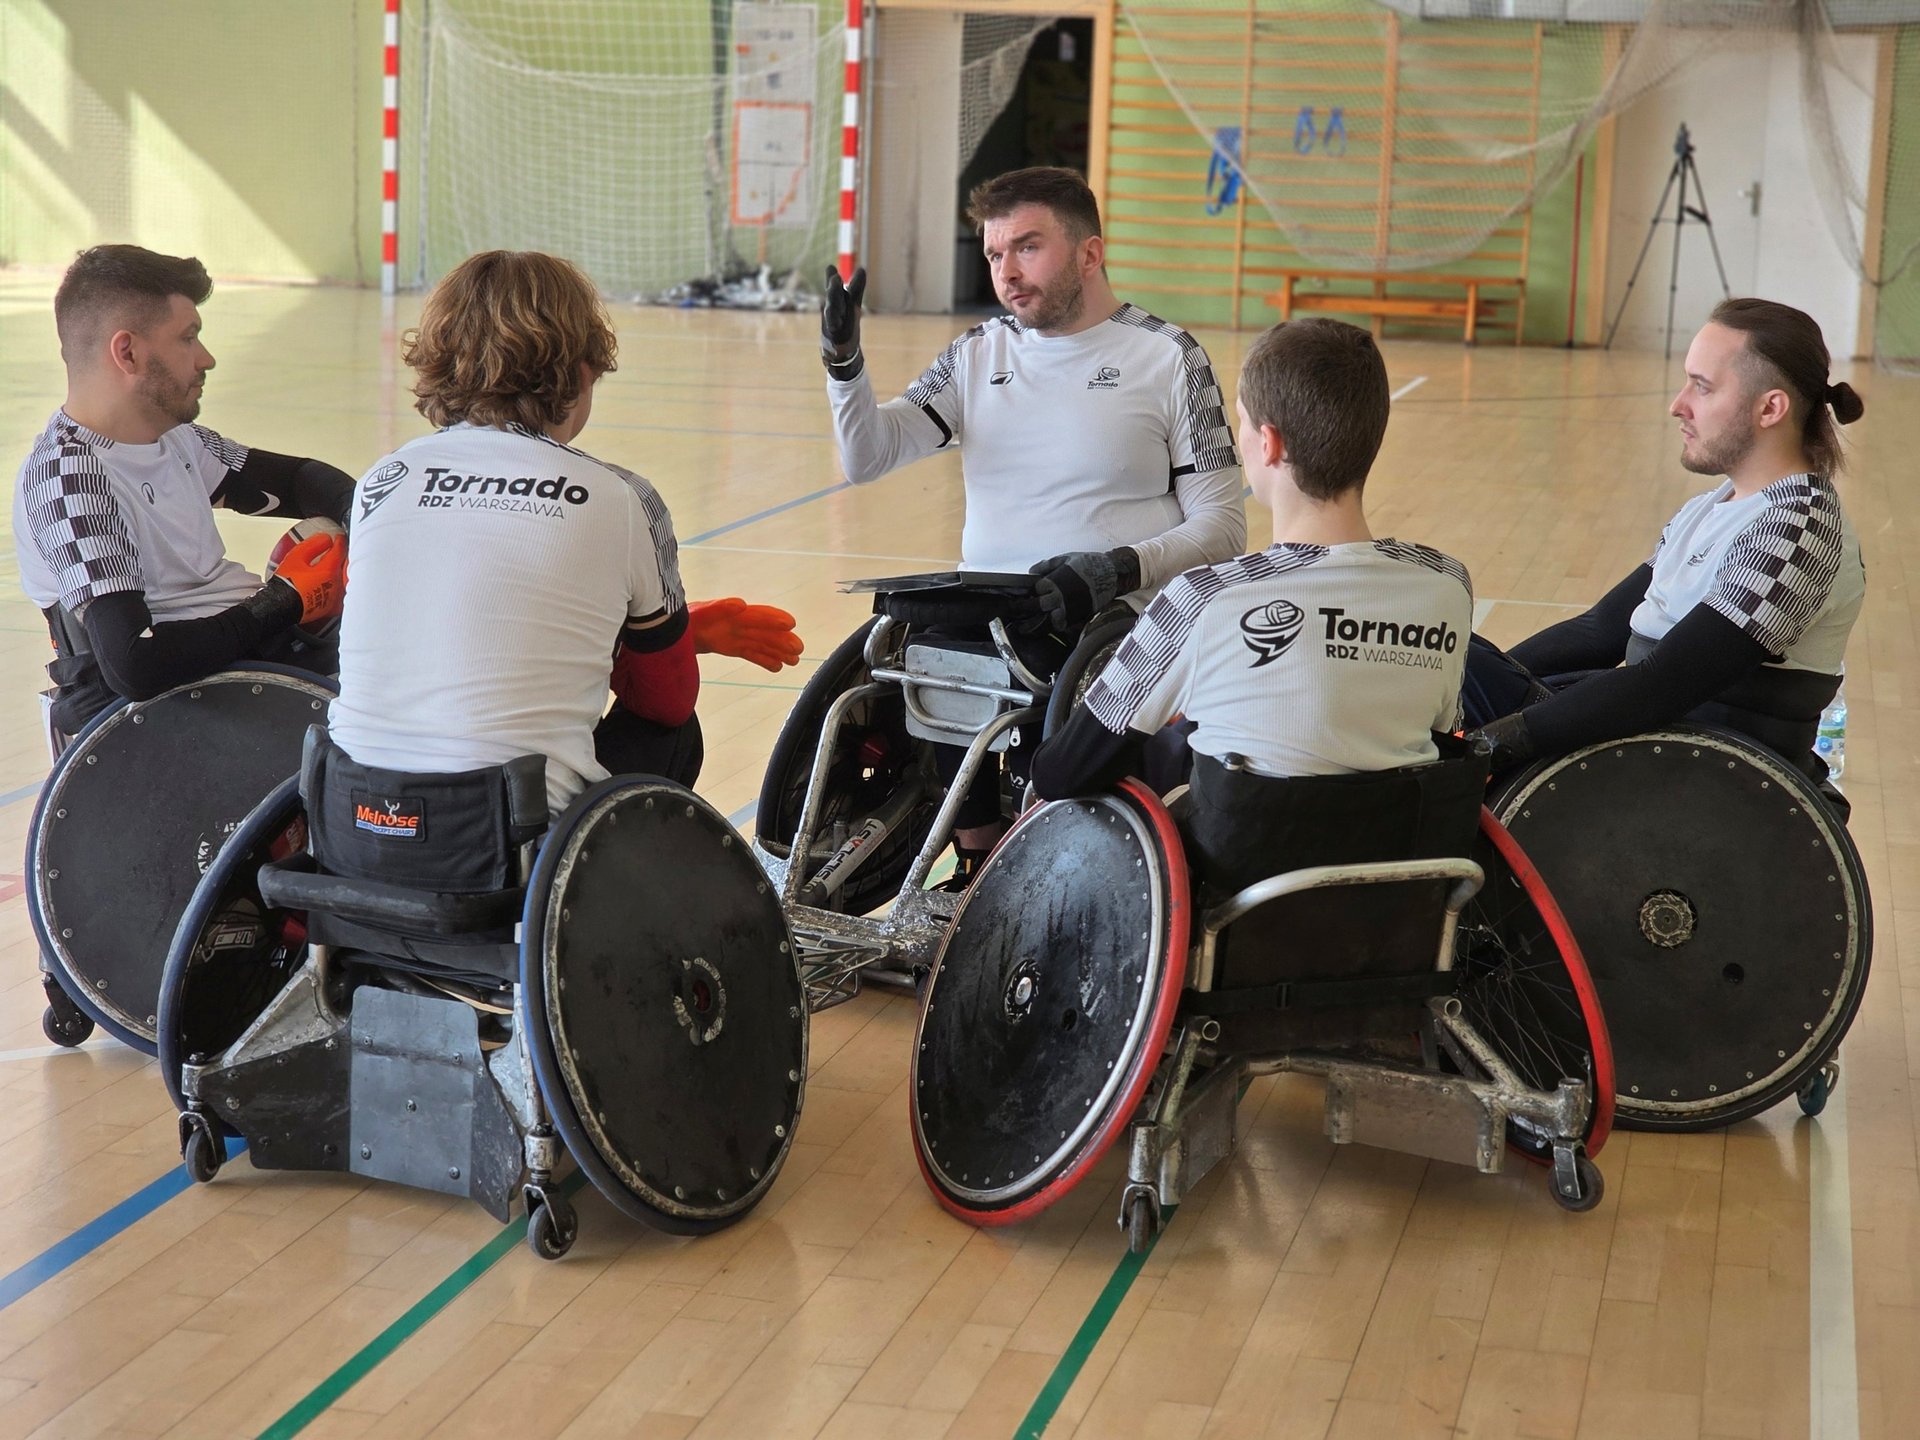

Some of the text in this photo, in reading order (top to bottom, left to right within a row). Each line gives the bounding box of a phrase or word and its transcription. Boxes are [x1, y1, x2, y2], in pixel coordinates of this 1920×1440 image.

[423, 467, 589, 505] Tornado
[418, 495, 565, 520] RDZ WARSZAWA
[1318, 607, 1457, 654] Tornado
[1325, 644, 1443, 671] RDZ WARSZAWA
